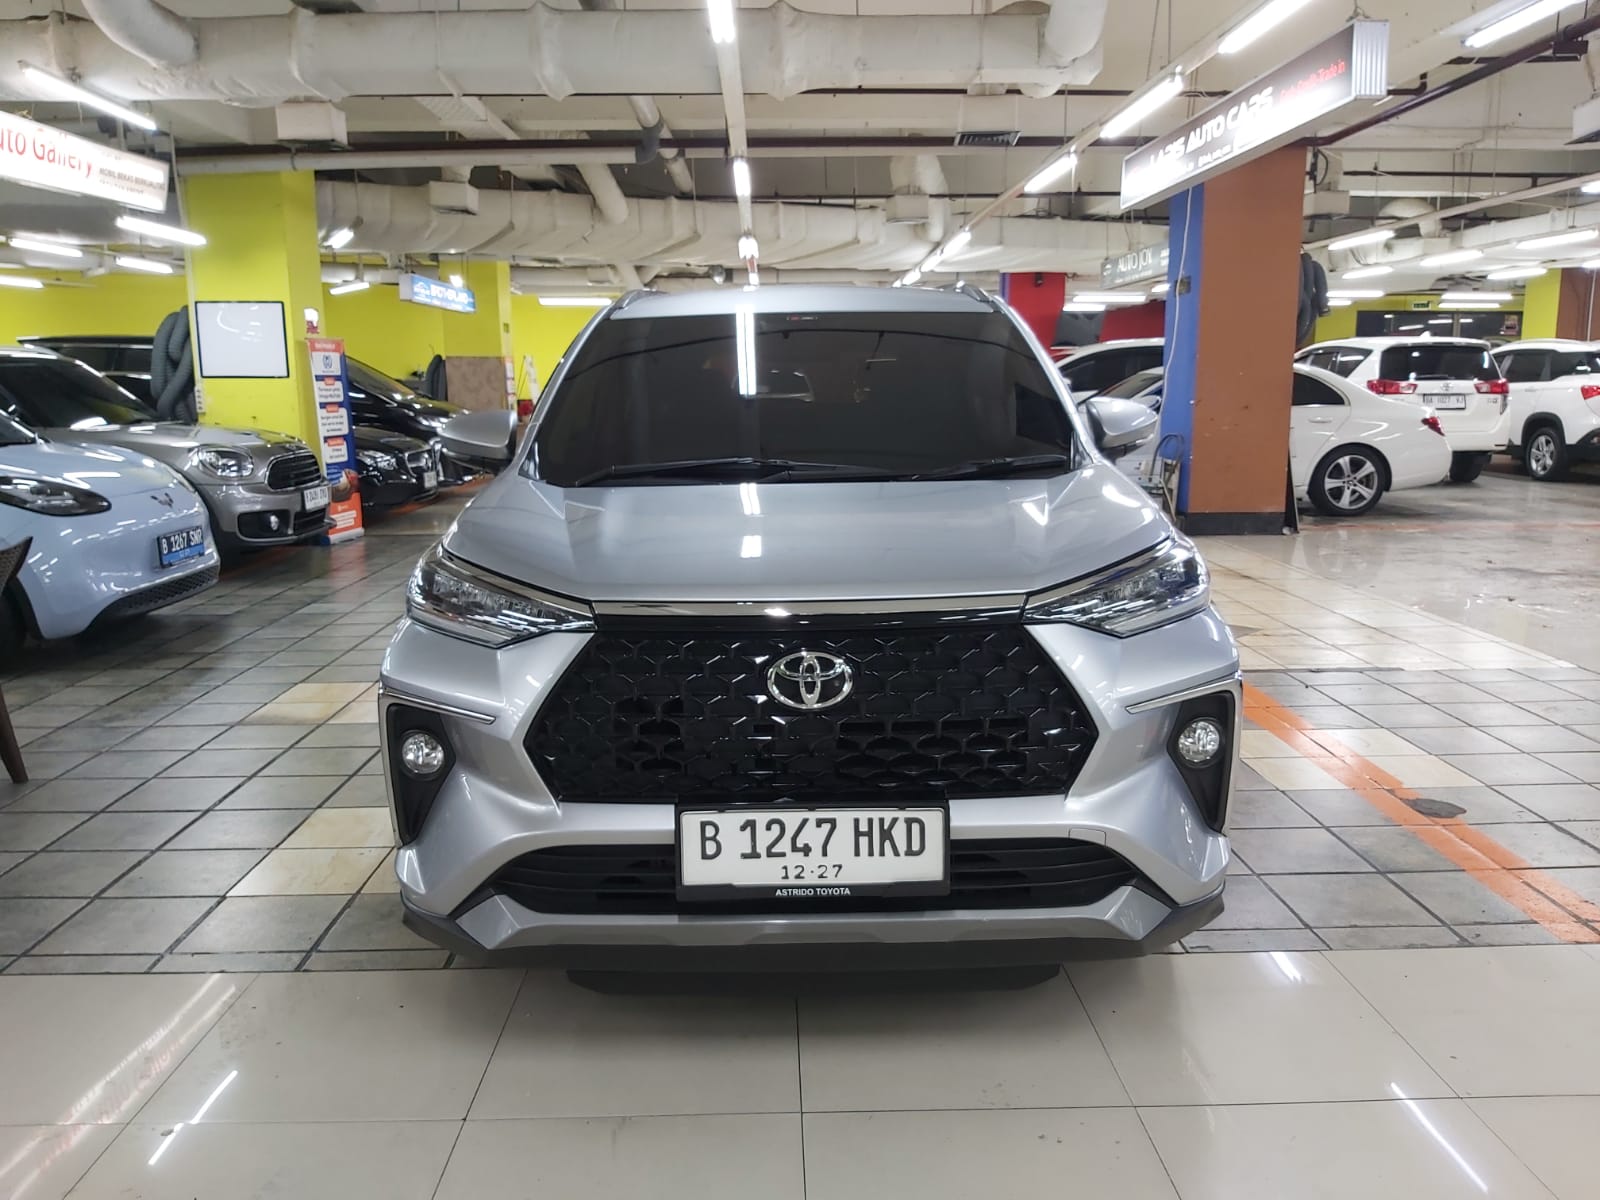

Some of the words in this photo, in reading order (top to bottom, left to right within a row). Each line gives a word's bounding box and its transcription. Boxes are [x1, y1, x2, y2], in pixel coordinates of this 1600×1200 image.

[1185, 115, 1226, 154] AUTO
[1117, 252, 1138, 273] AUTO
[162, 538, 168, 554] B
[170, 532, 187, 552] 1267
[700, 820, 722, 860] B
[739, 817, 837, 860] 1247
[853, 816, 926, 857] HKD
[775, 888, 814, 897] ASTRIDO
[816, 887, 851, 896] TOYOTA
